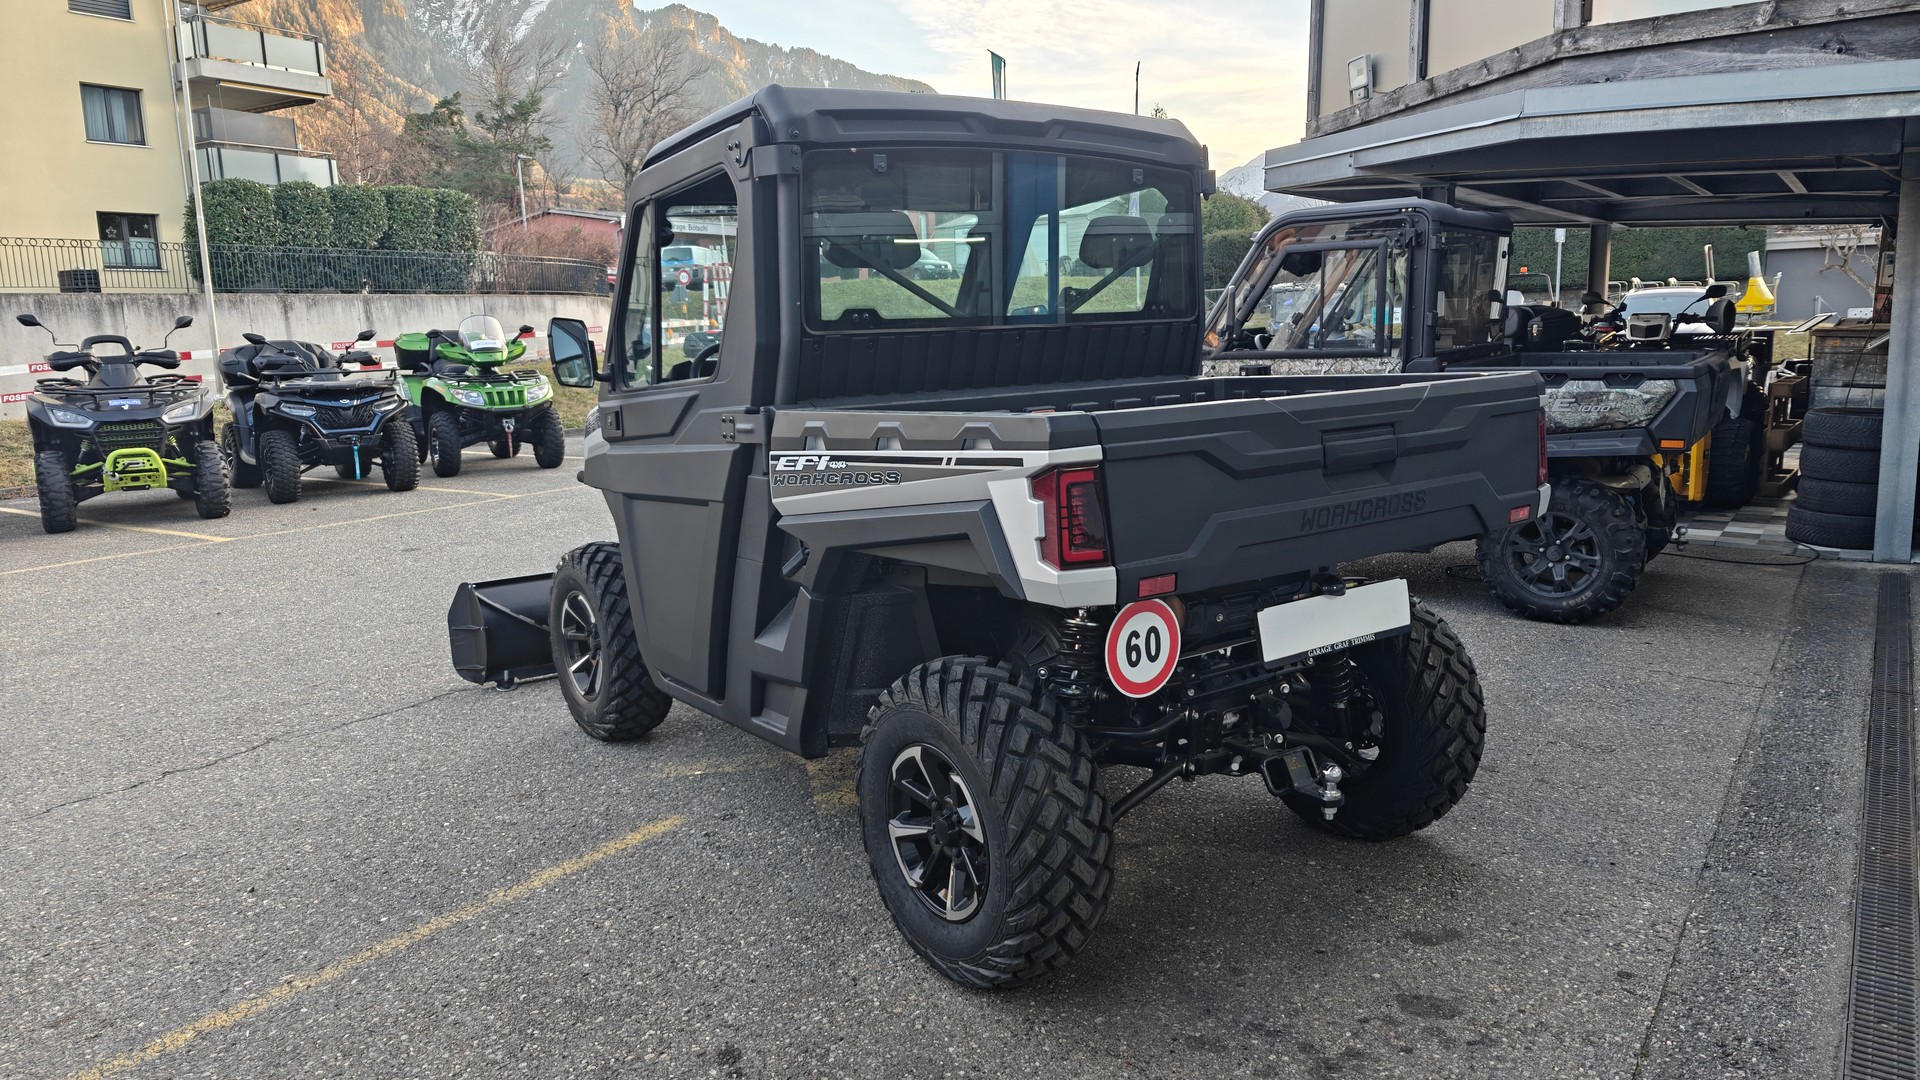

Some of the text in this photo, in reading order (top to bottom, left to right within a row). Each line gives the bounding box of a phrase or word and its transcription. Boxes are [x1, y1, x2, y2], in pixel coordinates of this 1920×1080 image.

[776, 456, 830, 470] EFI
[773, 470, 901, 486] WORKCROSS
[1301, 490, 1427, 531] WORKCROSS
[1126, 626, 1161, 668] 60
[1307, 633, 1376, 657] GARAGE GRAF TRIMMIS
